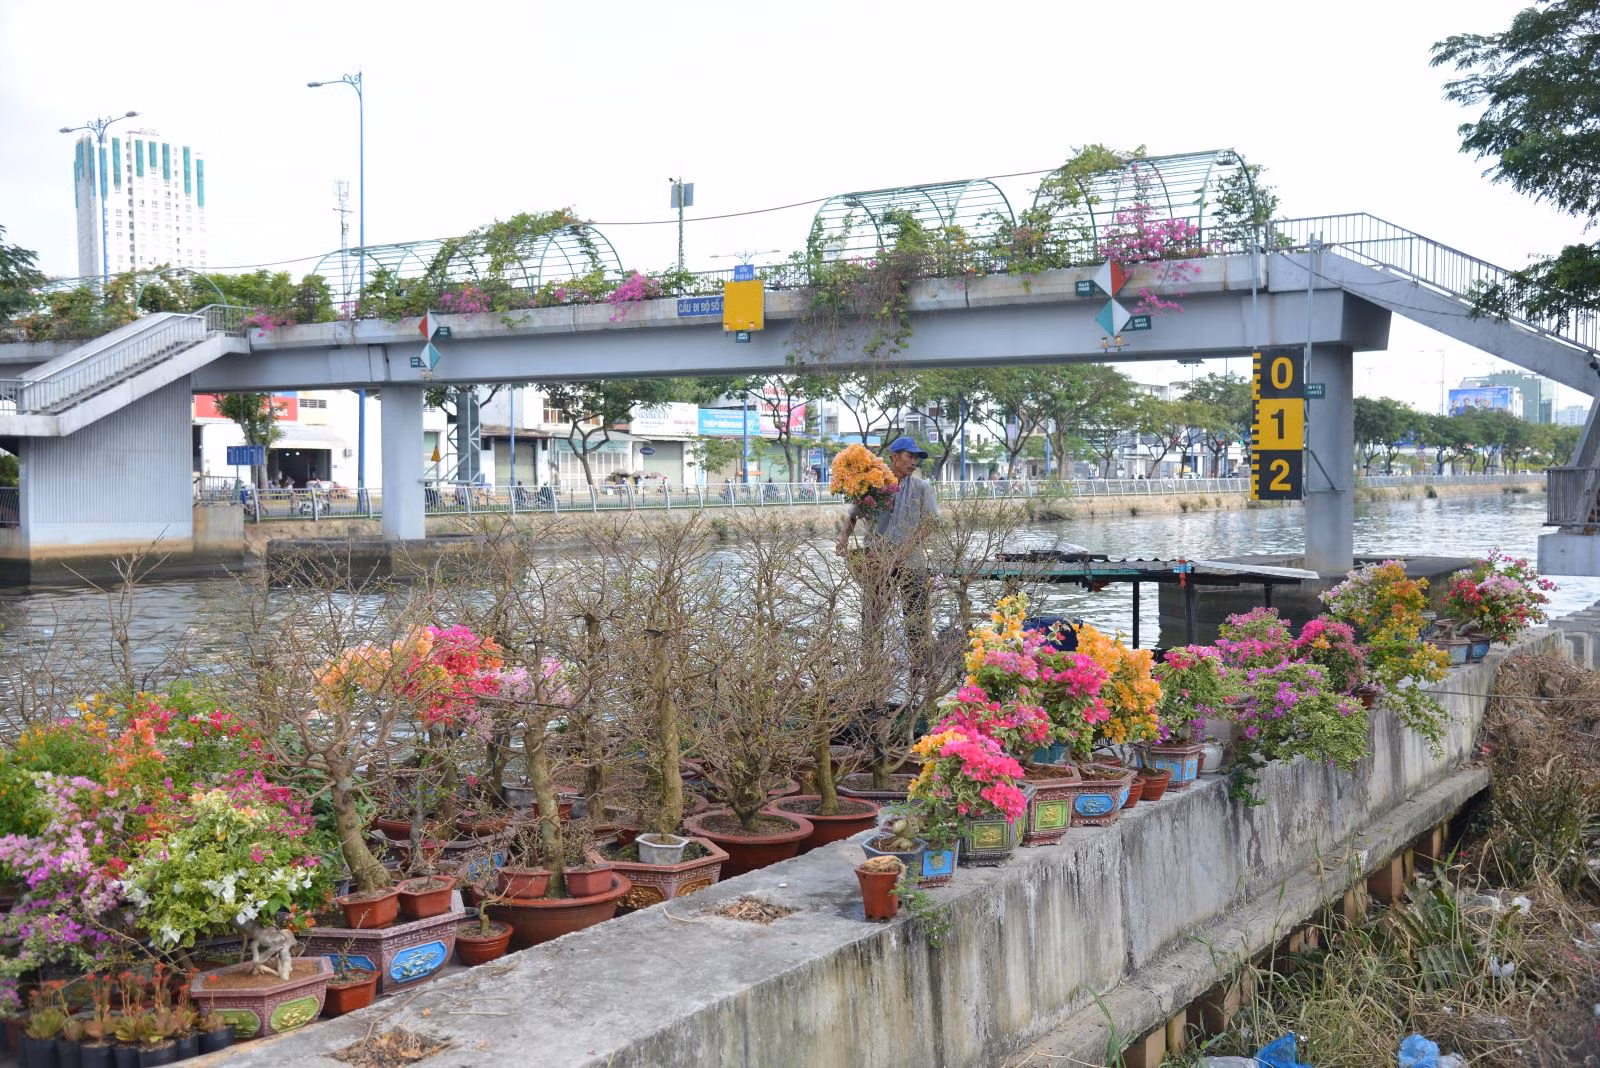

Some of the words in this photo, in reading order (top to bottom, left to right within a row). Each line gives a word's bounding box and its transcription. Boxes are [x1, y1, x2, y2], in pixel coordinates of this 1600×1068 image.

[693, 303, 699, 312] ĐI
[701, 301, 709, 313] BỘ
[711, 298, 719, 311] SỐ
[1271, 357, 1293, 390] 0
[1271, 409, 1284, 440] 1
[1269, 458, 1292, 491] 2
